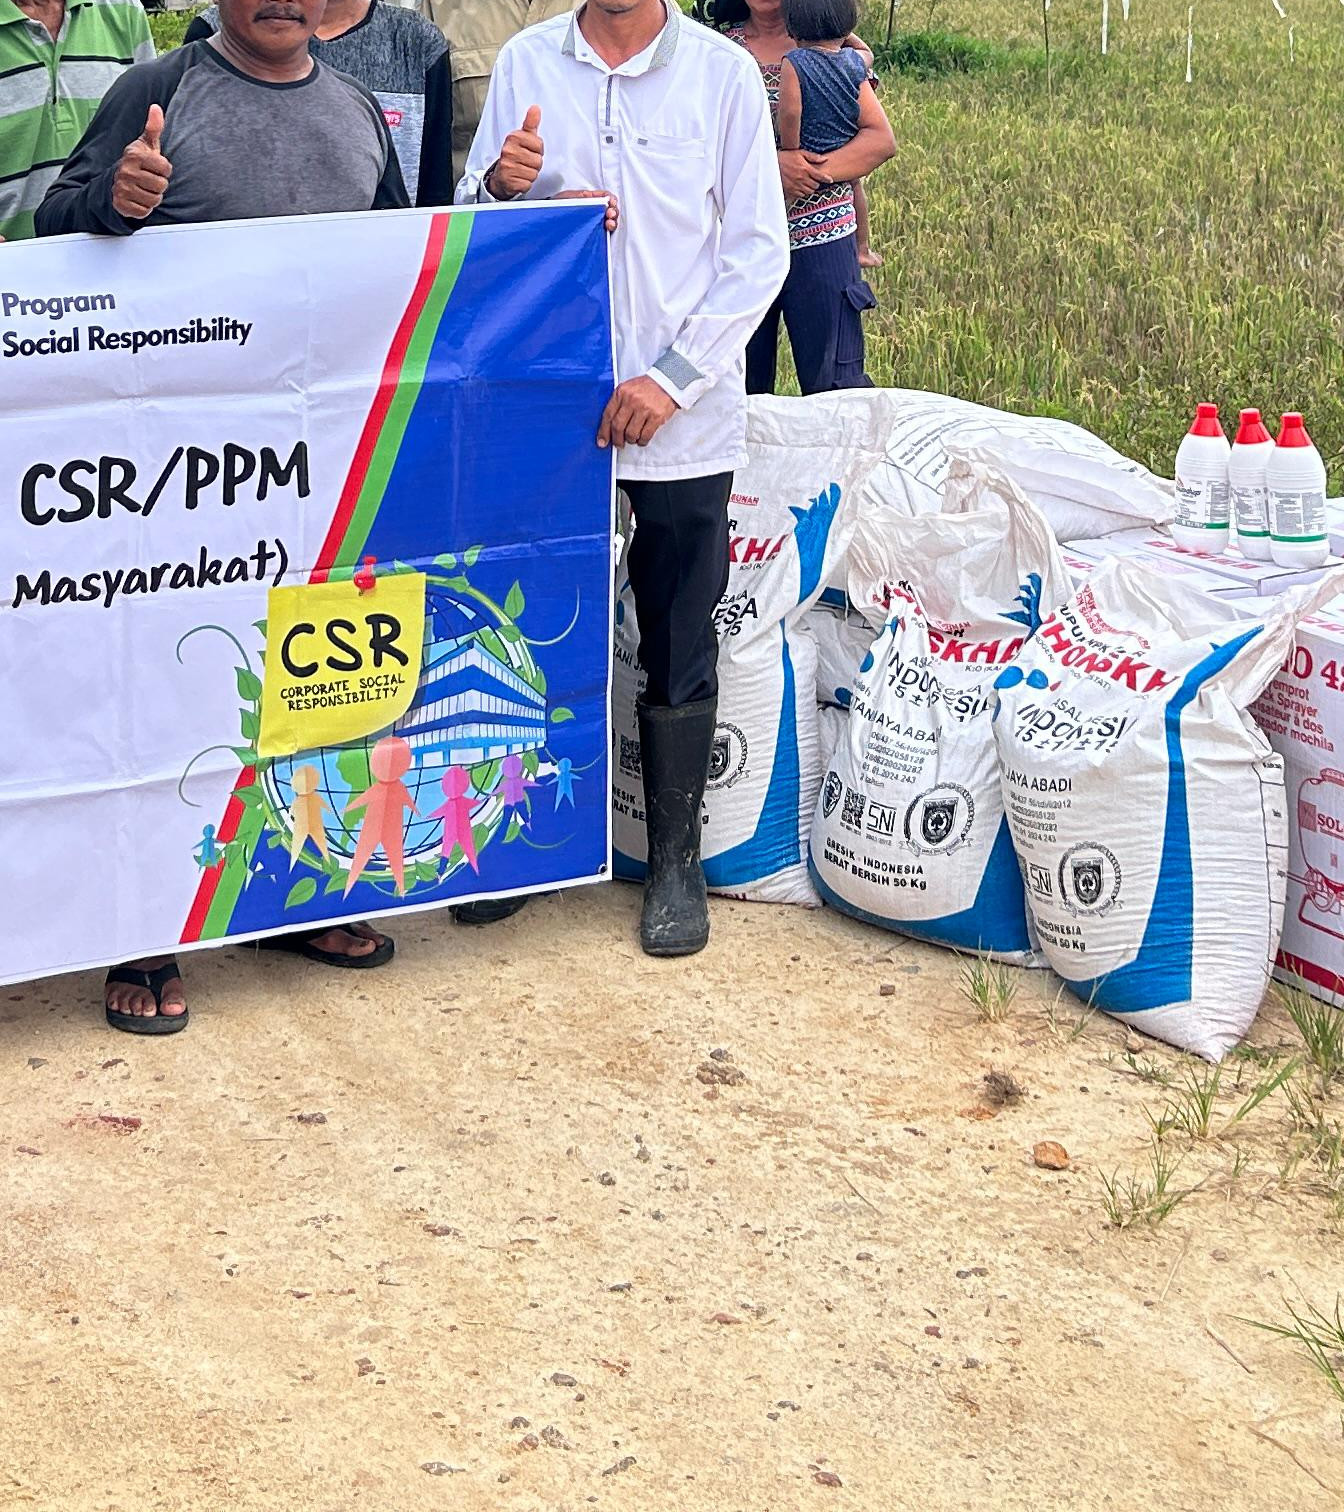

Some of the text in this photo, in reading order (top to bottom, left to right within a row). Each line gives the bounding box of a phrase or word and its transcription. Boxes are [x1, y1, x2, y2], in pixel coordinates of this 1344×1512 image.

[1, 292, 116, 320] Program
[3, 327, 80, 357] Social
[88, 317, 254, 354] Responsibility
[20, 441, 311, 527] CSR/PPM
[12, 538, 289, 609] Masyarakat)
[281, 613, 409, 678] CSR
[280, 673, 406, 699] CORPORATE SOCIAL
[287, 686, 399, 711] RESPONSIBILITY
[1277, 691, 1318, 718] Sprayer
[1290, 728, 1334, 753] mochila
[1303, 718, 1324, 734] dos
[1031, 777, 1073, 793] ABADI
[867, 803, 897, 834] SNI
[824, 849, 850, 871] BERAT
[852, 867, 890, 887] BERSIH
[893, 875, 907, 887] 50
[826, 837, 924, 875] GRESIK INDONESIA
